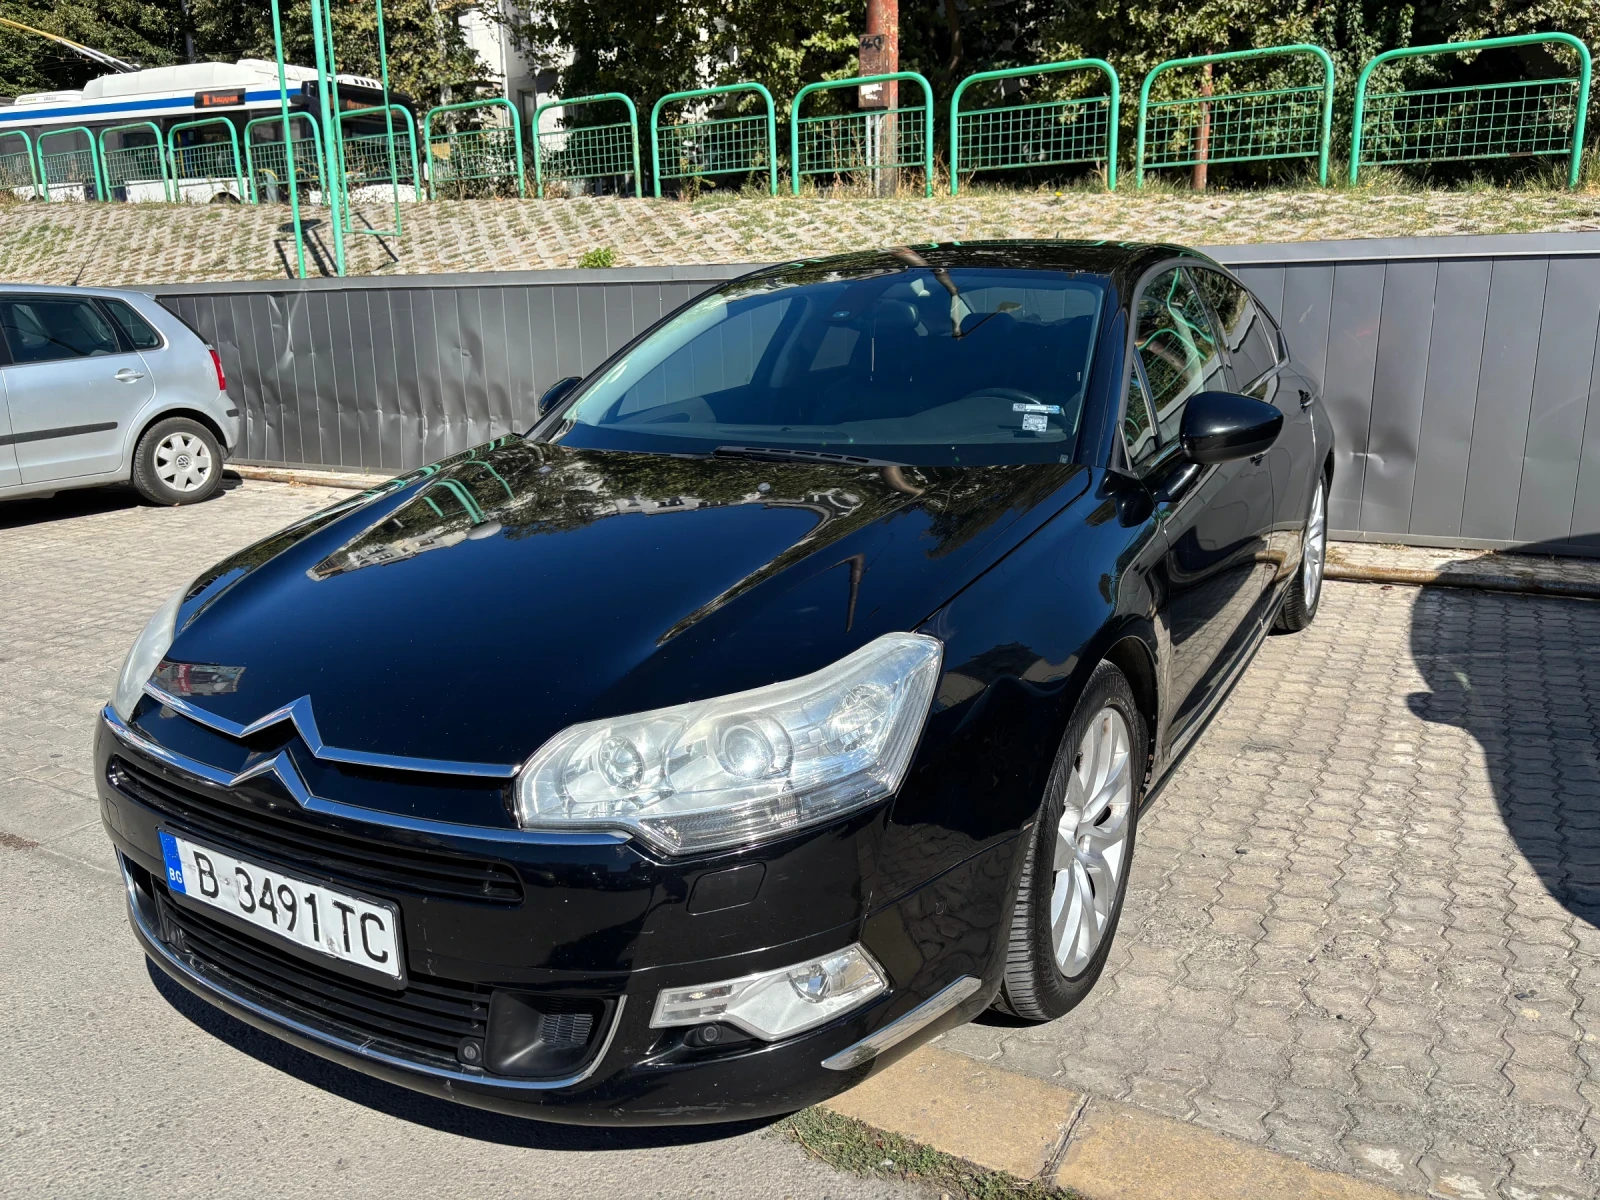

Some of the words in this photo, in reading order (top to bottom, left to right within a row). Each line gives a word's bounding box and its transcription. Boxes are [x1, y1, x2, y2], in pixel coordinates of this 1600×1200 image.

[169, 866, 183, 884] BG
[193, 851, 219, 899] B
[235, 866, 321, 943] 3491
[332, 898, 389, 964] TC
